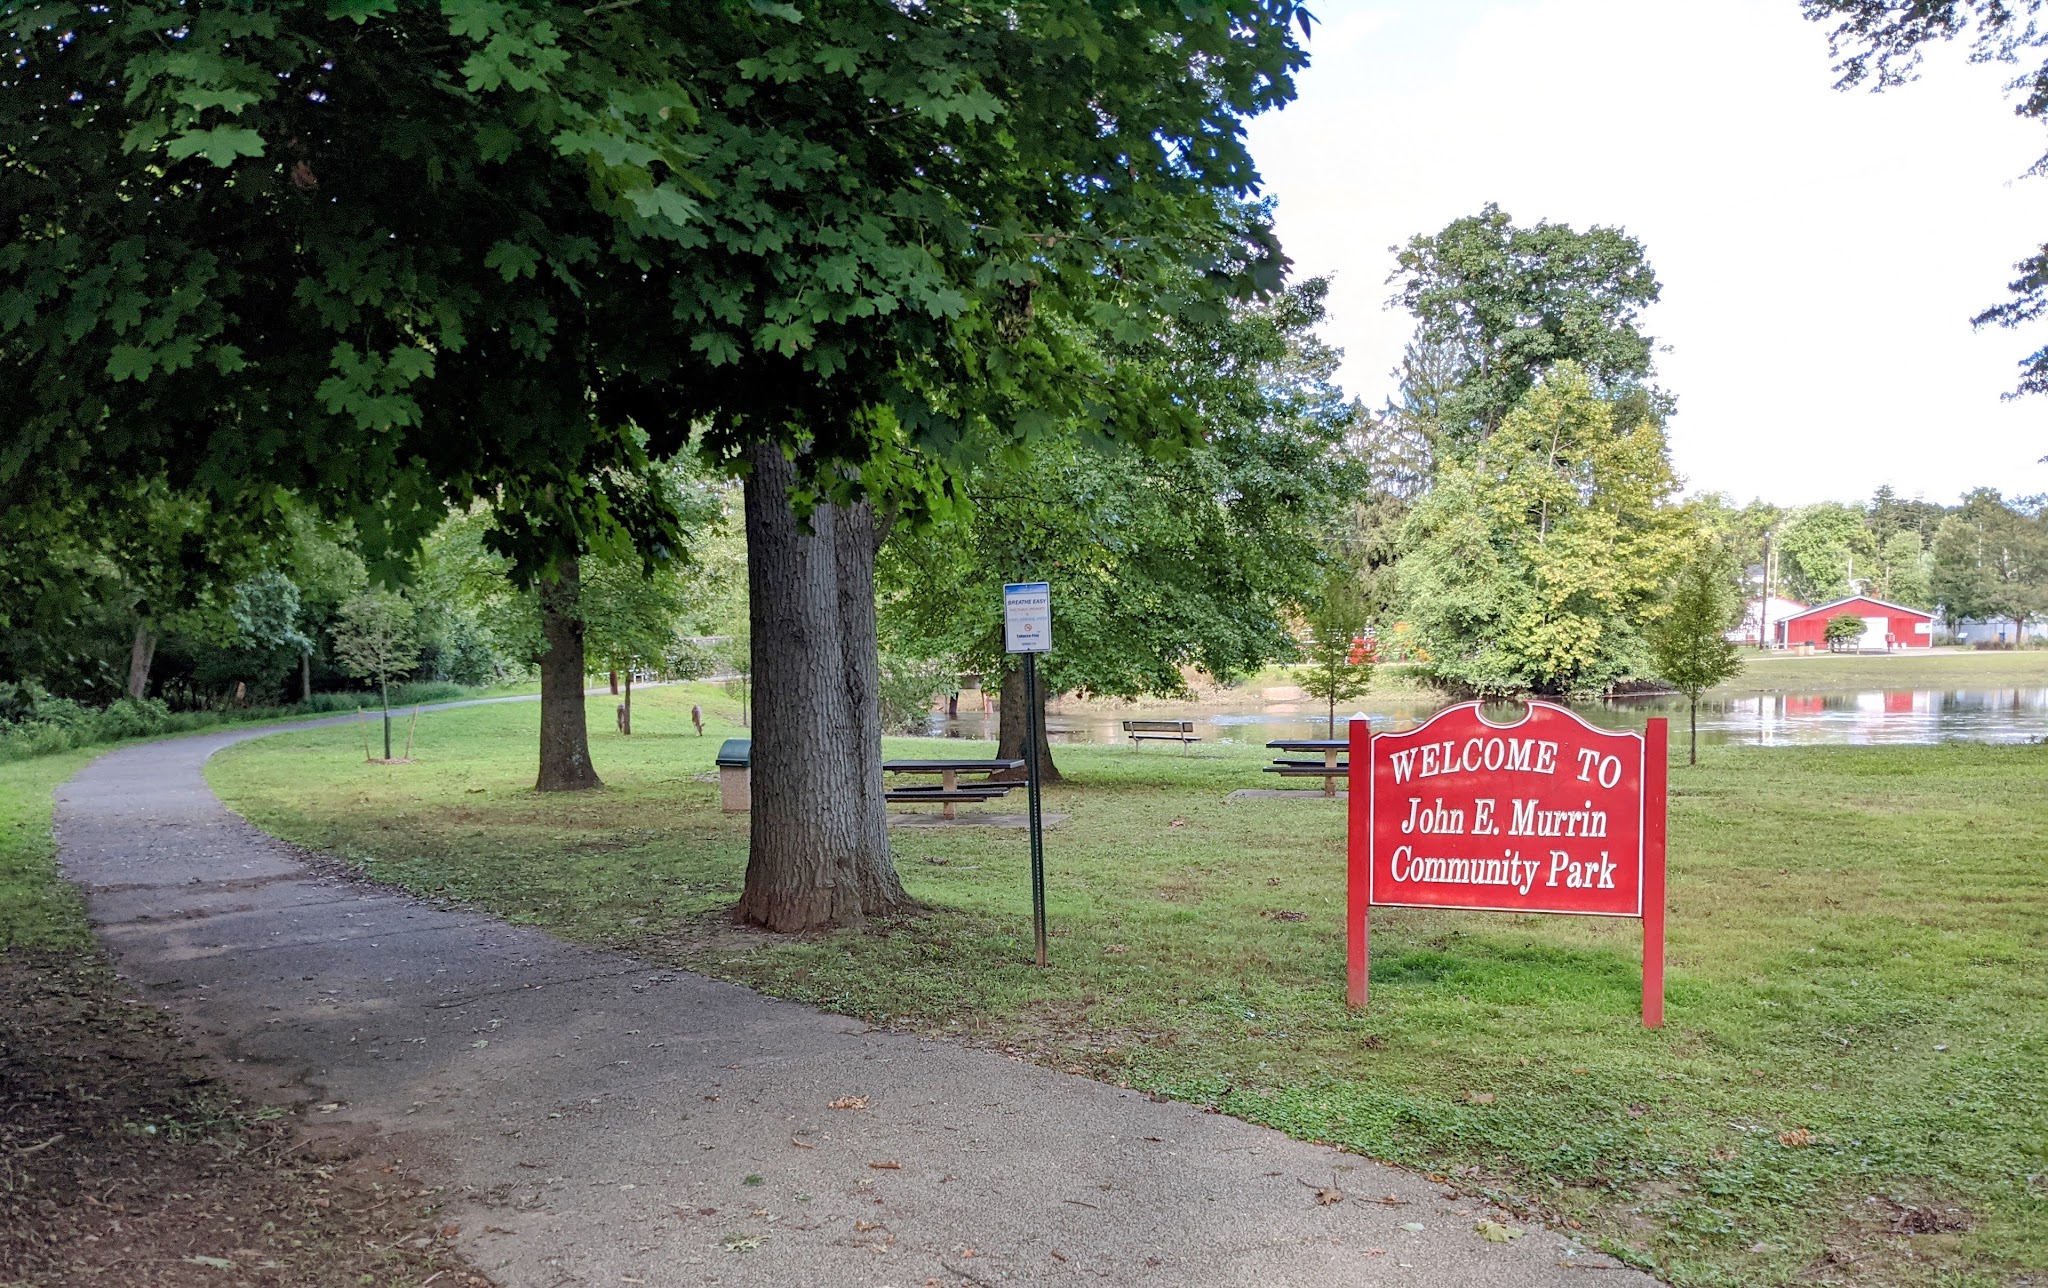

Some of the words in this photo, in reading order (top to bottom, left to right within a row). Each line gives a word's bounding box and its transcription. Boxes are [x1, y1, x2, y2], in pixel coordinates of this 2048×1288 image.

[1390, 737, 1558, 784] WELCOME
[1577, 747, 1622, 788] TO
[1401, 798, 1464, 835] John
[1471, 798, 1500, 836] E.
[1508, 799, 1607, 838] Murrin
[1391, 846, 1540, 895] Community
[1546, 850, 1617, 889] Park
